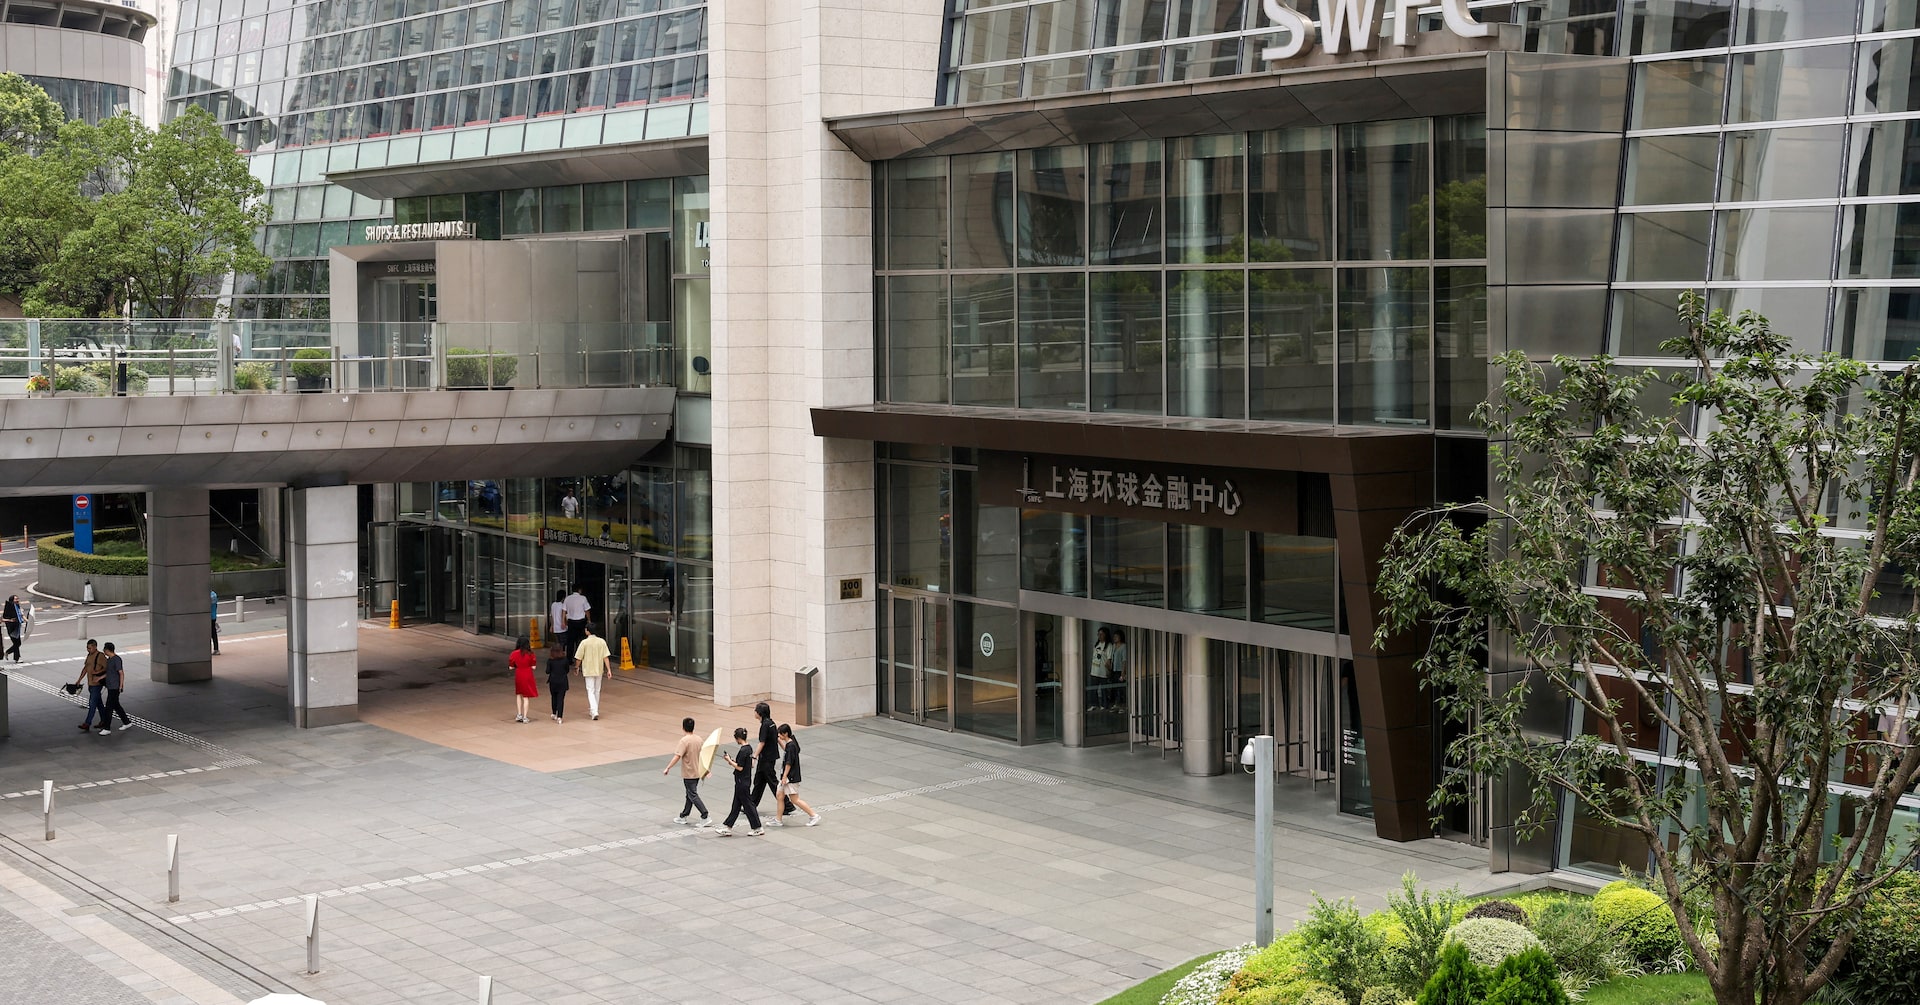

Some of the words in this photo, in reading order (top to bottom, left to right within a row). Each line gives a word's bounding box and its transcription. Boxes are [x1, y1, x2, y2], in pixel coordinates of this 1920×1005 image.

[365, 225, 392, 241] SHOPS
[392, 224, 401, 239] &
[401, 221, 464, 239] RESTAURANTS
[387, 264, 400, 273] SWFC
[1045, 466, 1240, 515] 上海环球金融中心
[568, 533, 578, 543] The
[578, 535, 593, 547] Shops
[599, 540, 629, 550] Restaurants
[843, 581, 859, 590] 100
